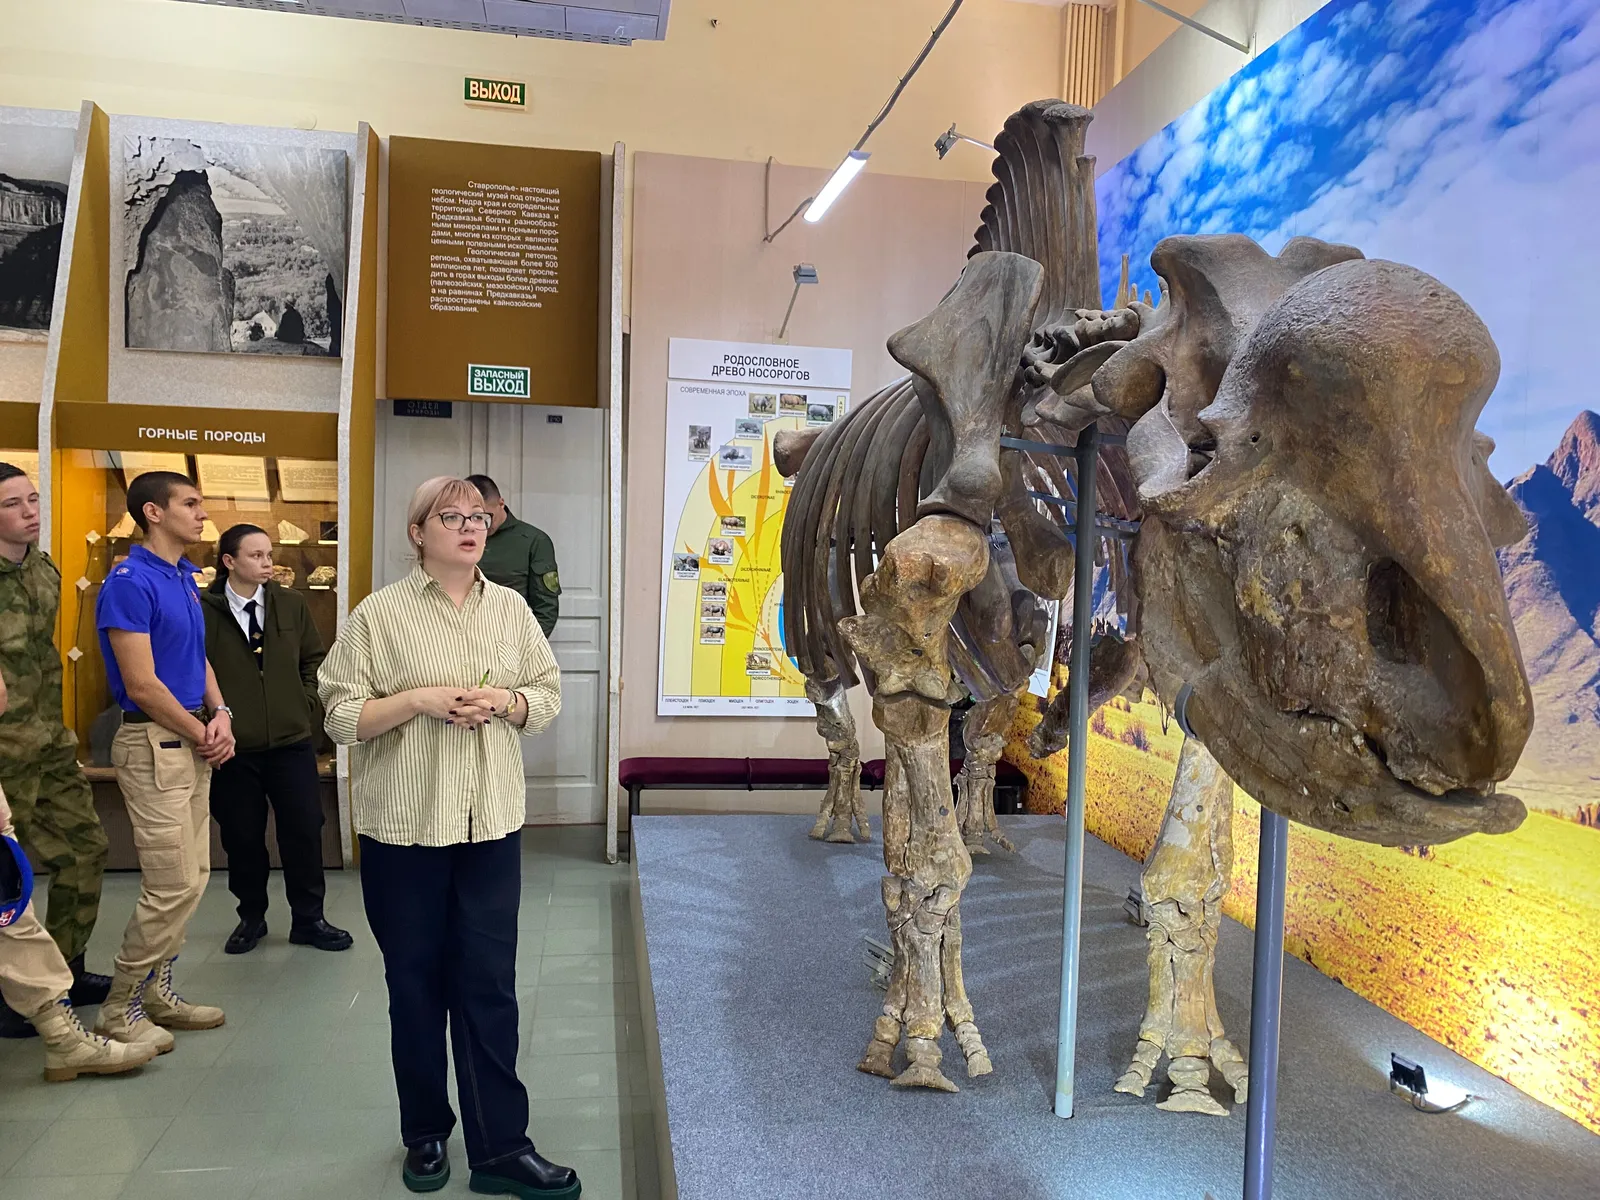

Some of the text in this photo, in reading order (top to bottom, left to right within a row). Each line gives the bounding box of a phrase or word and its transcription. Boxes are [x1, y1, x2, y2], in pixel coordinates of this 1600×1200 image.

[470, 80, 520, 103] ВЫХОД
[432, 188, 483, 198] геологический
[525, 195, 560, 203] открытым
[521, 186, 559, 195] настоящий
[459, 198, 481, 207] Недра
[508, 203, 559, 211] сопредельных
[432, 205, 473, 213] территорий
[479, 207, 516, 216] Северного
[522, 211, 550, 219] Кавказа
[432, 212, 482, 222] Предкавказья
[486, 216, 510, 224] богаты
[468, 248, 557, 260] Геологическая летопись
[508, 244, 558, 252] ископаемыми.
[464, 257, 518, 266] охватывающая
[430, 279, 484, 288] (палеозойских,
[486, 283, 533, 292] мезозойских)
[487, 290, 536, 300] Предкавказья
[430, 296, 542, 308] распространены кайнозойские
[724, 354, 800, 368] РОДОСЛОВНОЕ
[474, 369, 524, 380] ЗАПАСНЫЙ
[712, 366, 810, 380] ДРЕВО НОСОРОГОВ
[474, 378, 524, 394] ВЫХОД
[680, 386, 746, 397] СОВРЕМЕННАЯ ЭПОХА
[408, 401, 438, 410] ОТДЕЛ
[138, 427, 266, 444] ГОРНЫЕ ПОРОДЫ
